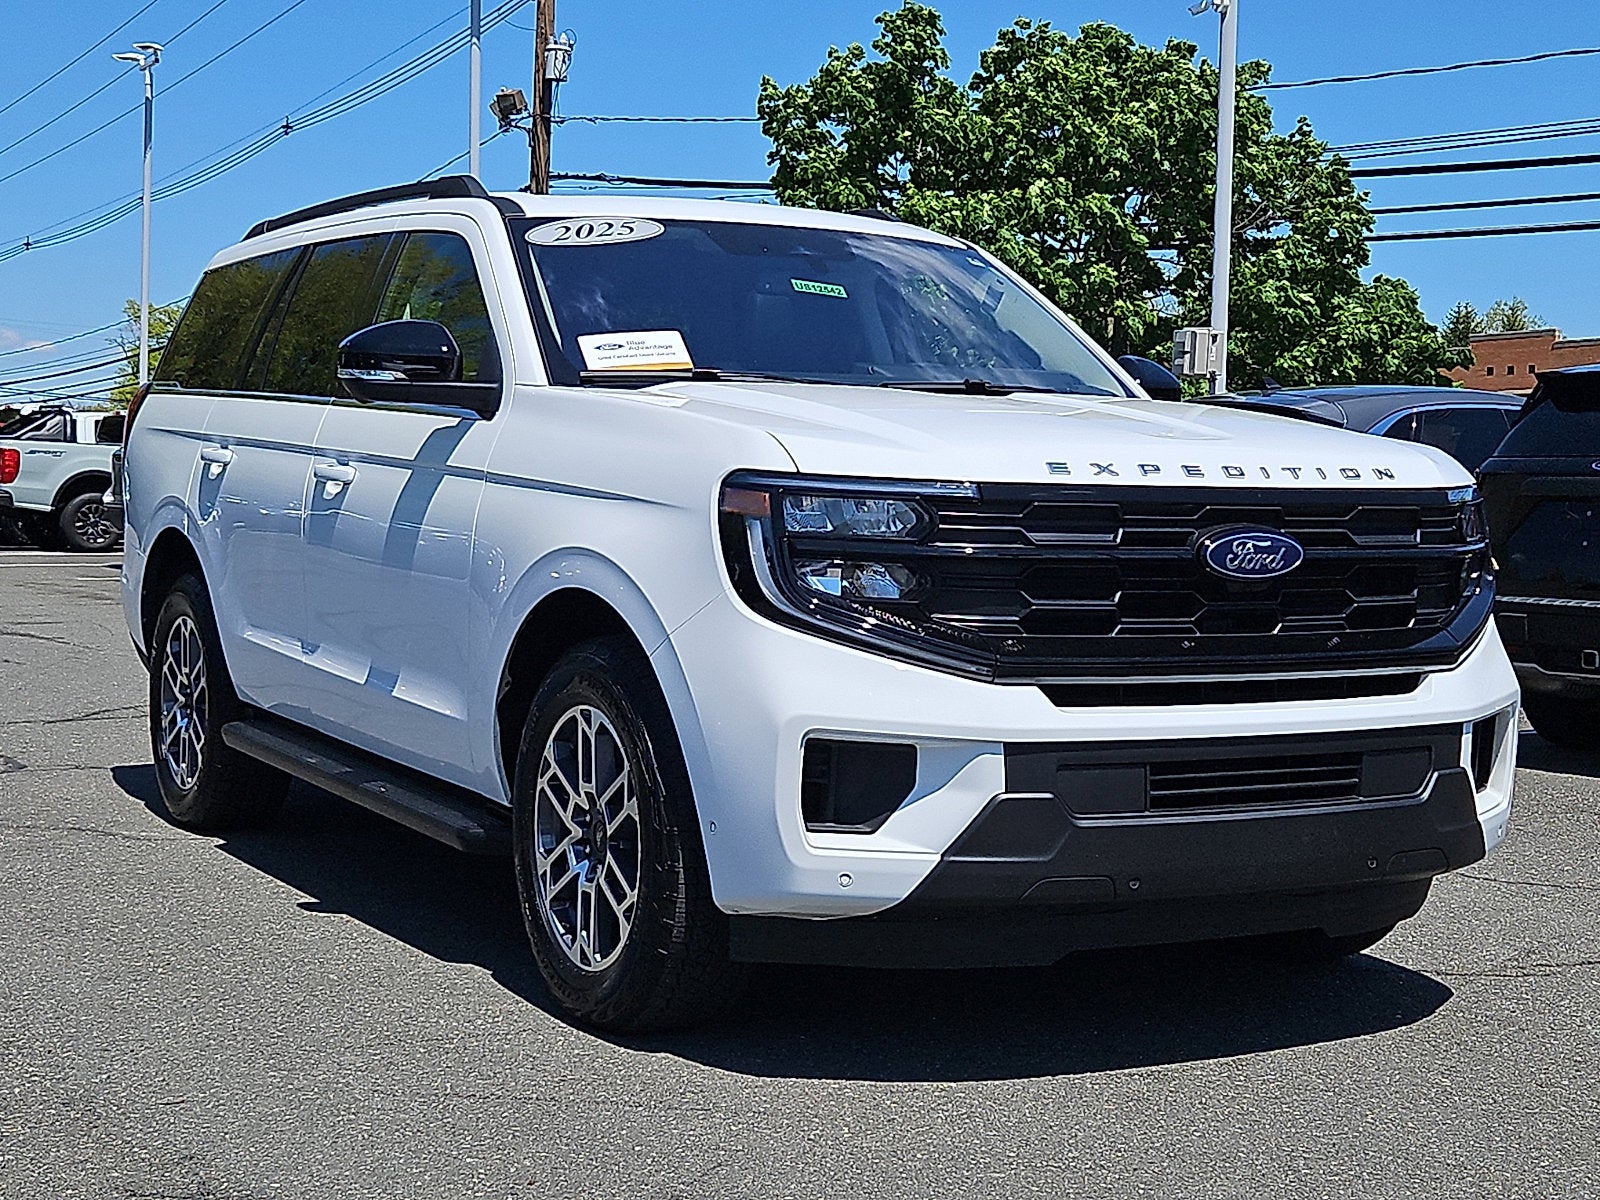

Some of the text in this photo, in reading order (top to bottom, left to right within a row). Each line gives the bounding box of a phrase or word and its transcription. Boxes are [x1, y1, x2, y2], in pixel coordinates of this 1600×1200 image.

[553, 221, 636, 242] 2025
[1045, 462, 1395, 481] EXPEDITION
[1226, 539, 1286, 570] Ford
